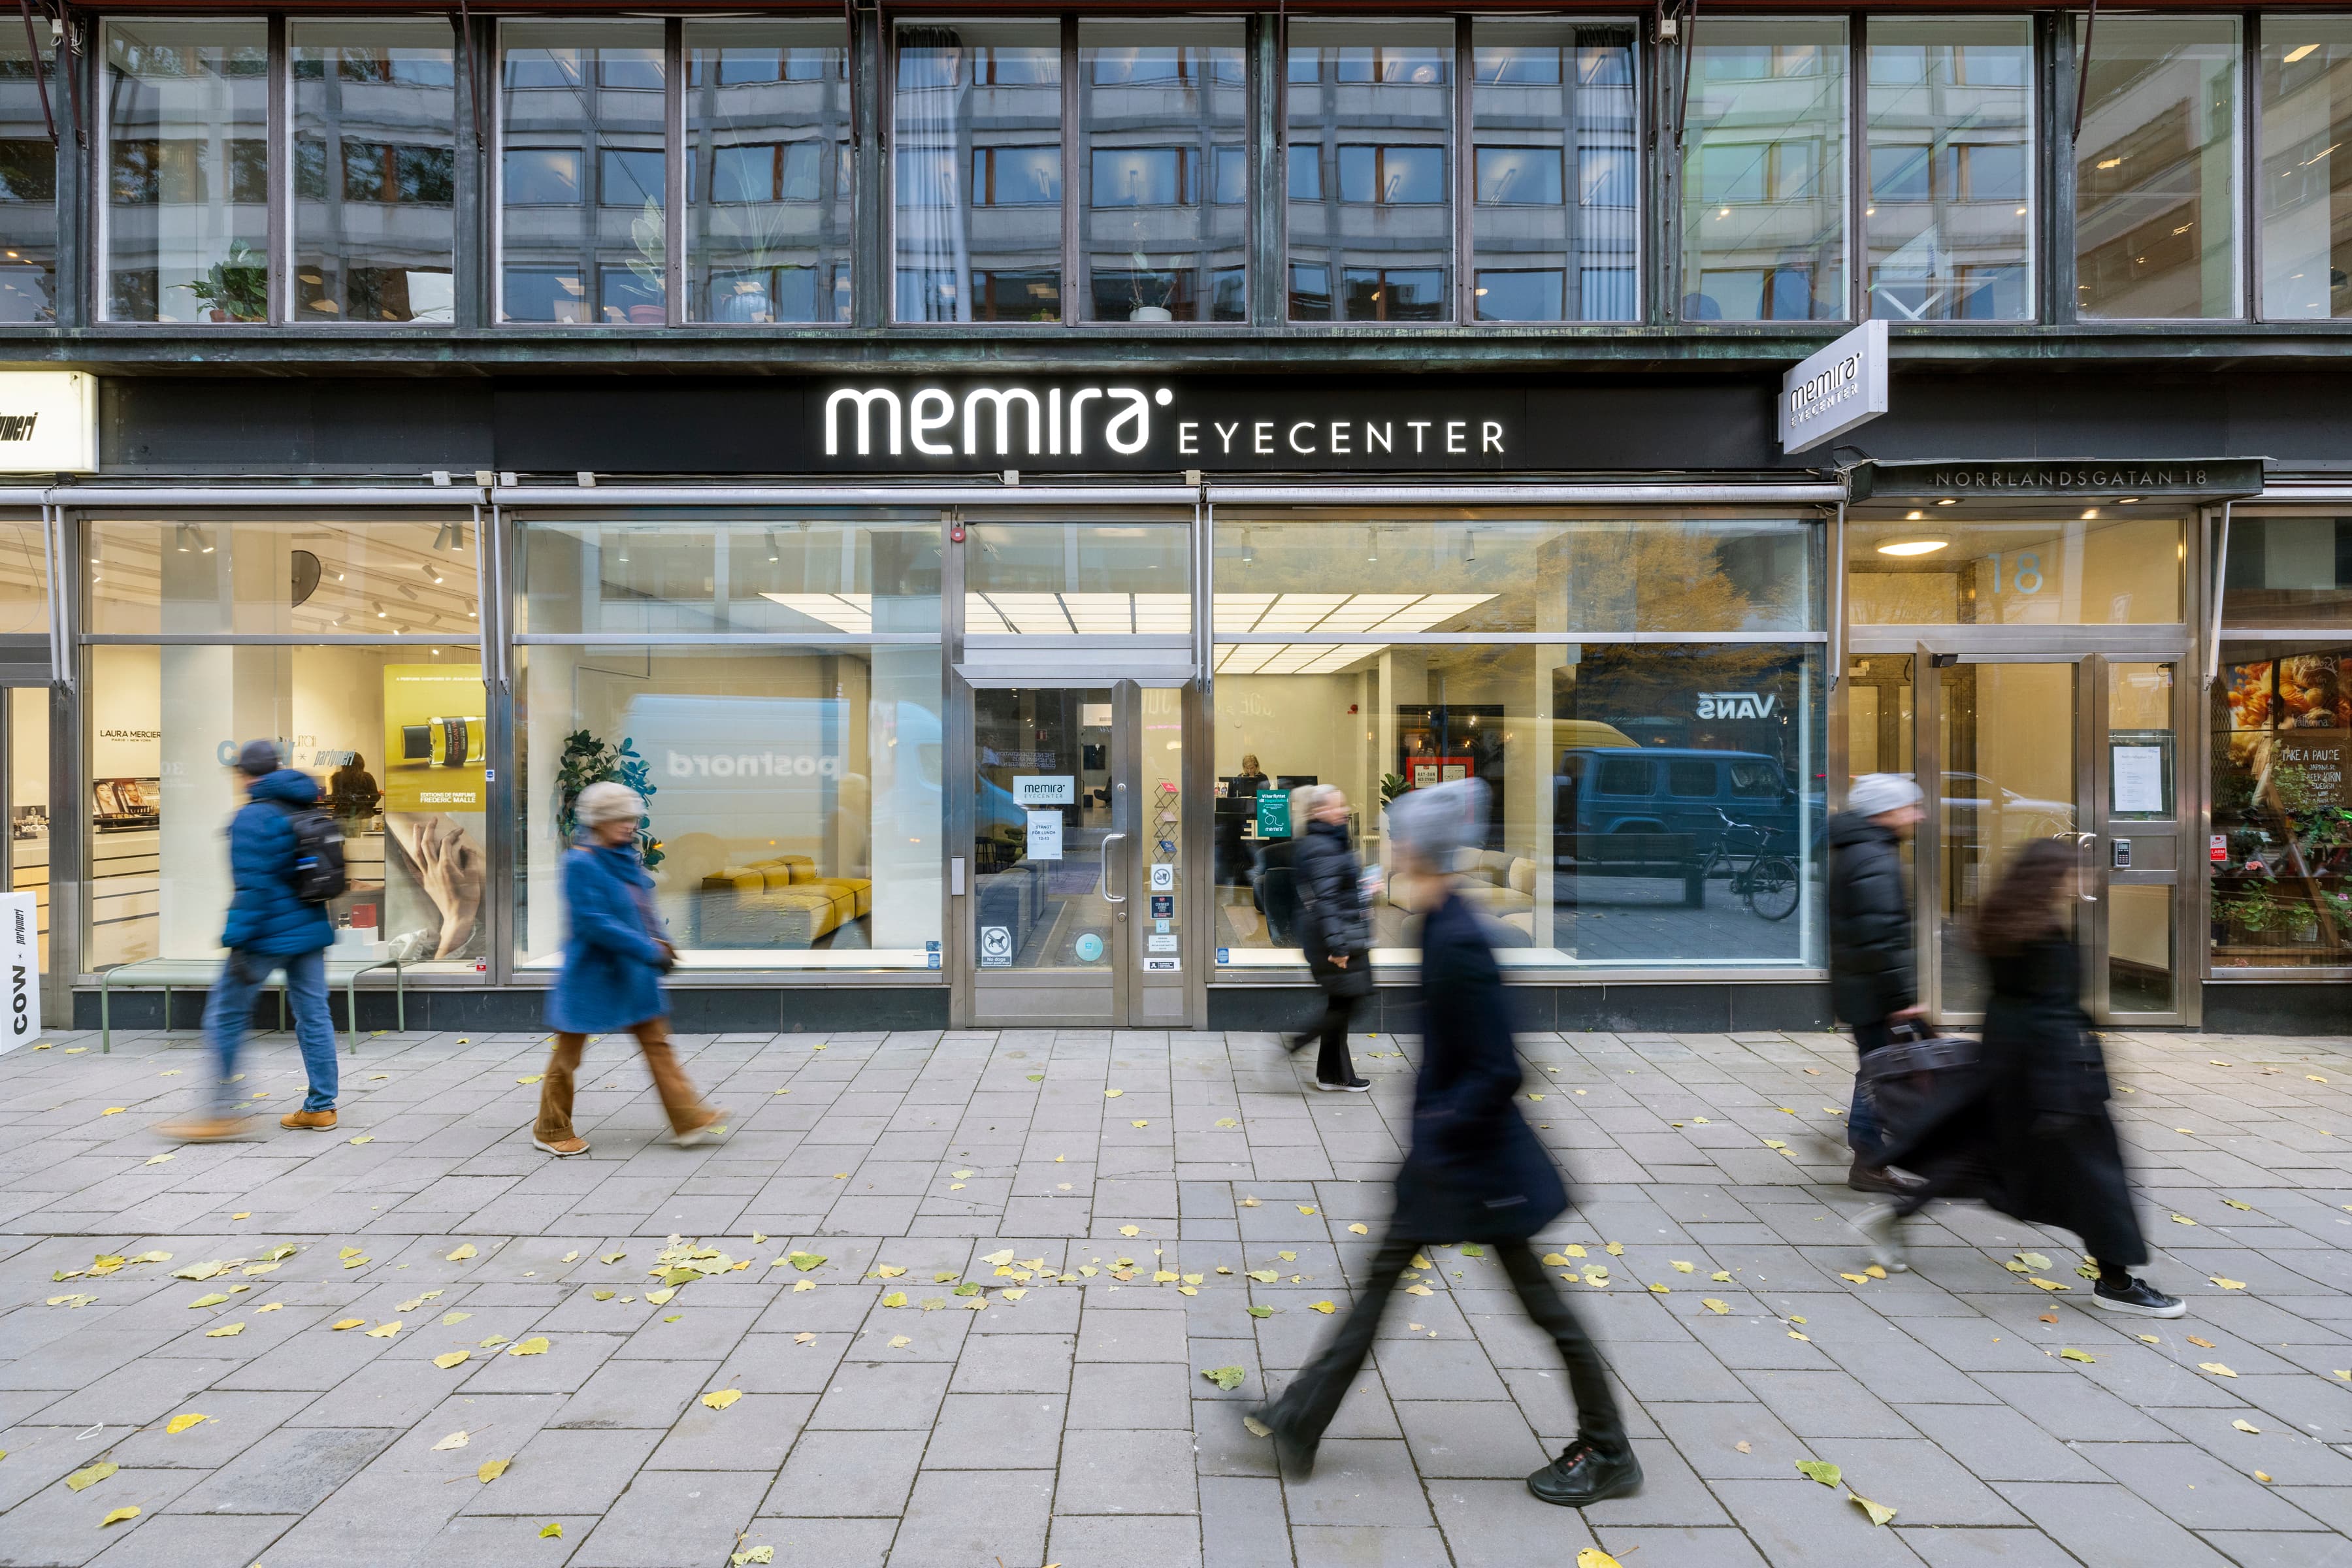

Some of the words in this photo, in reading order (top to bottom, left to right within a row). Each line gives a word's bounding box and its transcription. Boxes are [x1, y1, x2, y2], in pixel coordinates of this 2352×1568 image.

[1790, 353, 1857, 412] memira
[826, 388, 1151, 455] memira
[1179, 422, 1505, 453] EYECENTER
[1790, 384, 1858, 429] EYECENTER
[1935, 470, 2172, 487] NORRLANDSGATAN
[2185, 470, 2207, 485] 18
[1987, 553, 2044, 595] 18
[313, 749, 356, 768] parfymeri
[2281, 749, 2301, 760] TAKE
[2303, 749, 2309, 760] A
[1024, 784, 1064, 792] memira
[2323, 772, 2341, 782] KIRIN
[14, 909, 25, 945] parfymeri
[12, 965, 27, 1035] COW
